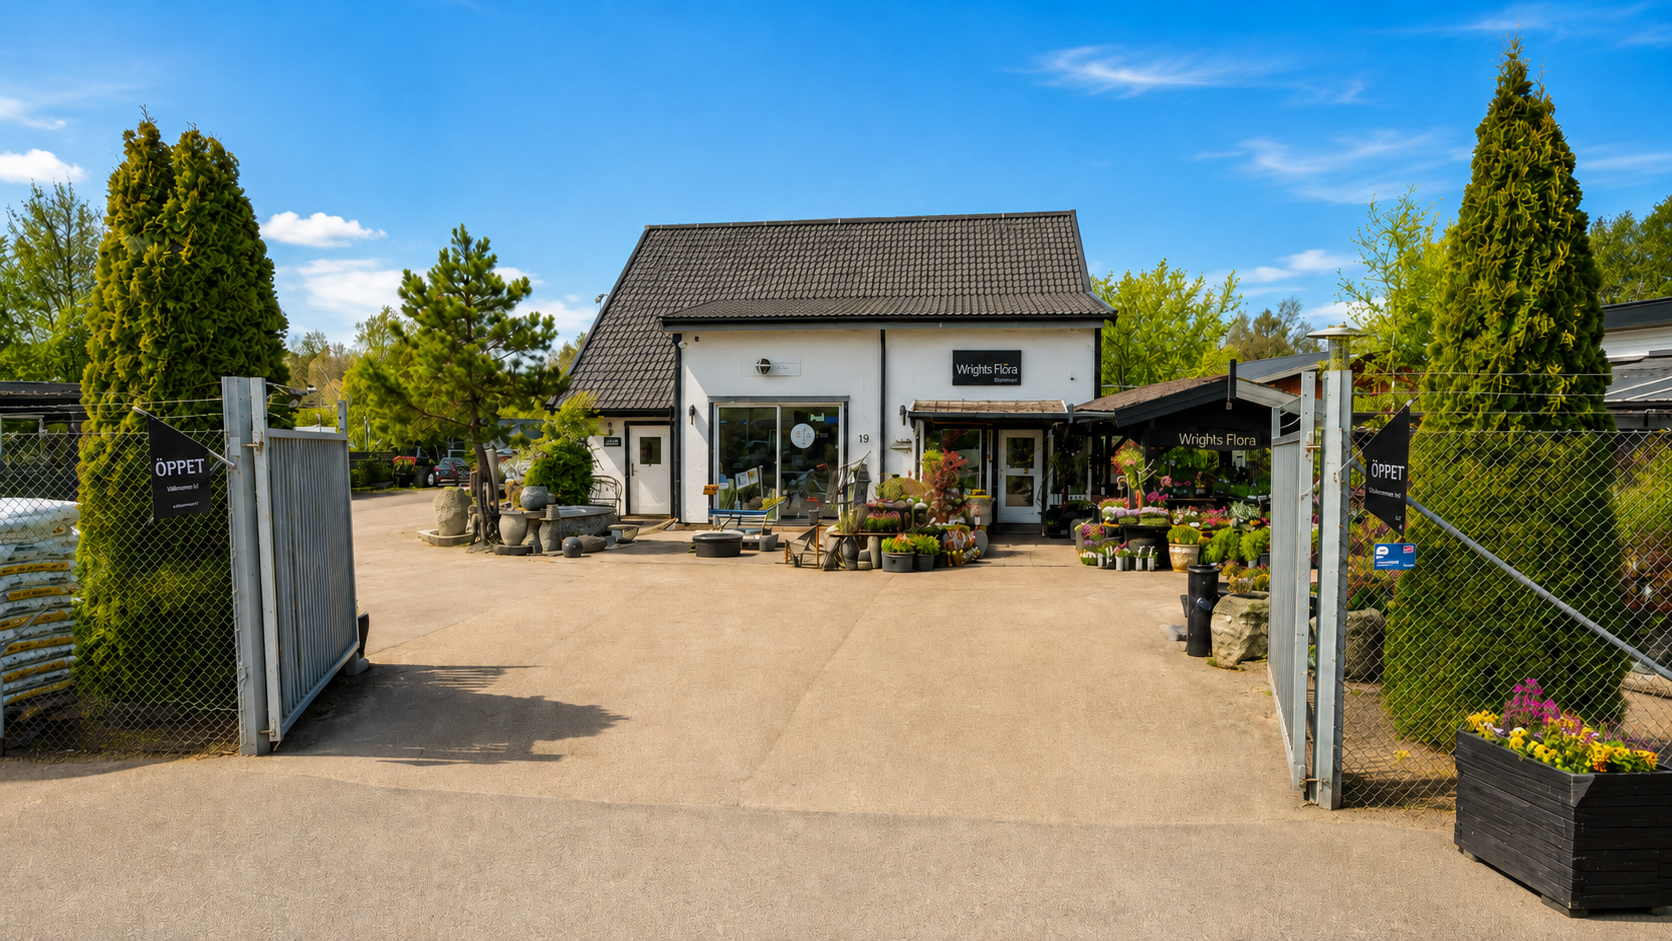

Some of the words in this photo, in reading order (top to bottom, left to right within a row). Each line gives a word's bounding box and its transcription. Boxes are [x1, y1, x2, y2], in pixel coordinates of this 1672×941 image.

[956, 364, 993, 377] Wrights
[858, 434, 869, 443] 19
[1179, 433, 1223, 448] Wrights
[1226, 433, 1256, 446] Flora
[155, 458, 204, 477] ÖPPET
[1371, 459, 1405, 481] ÖPPET
